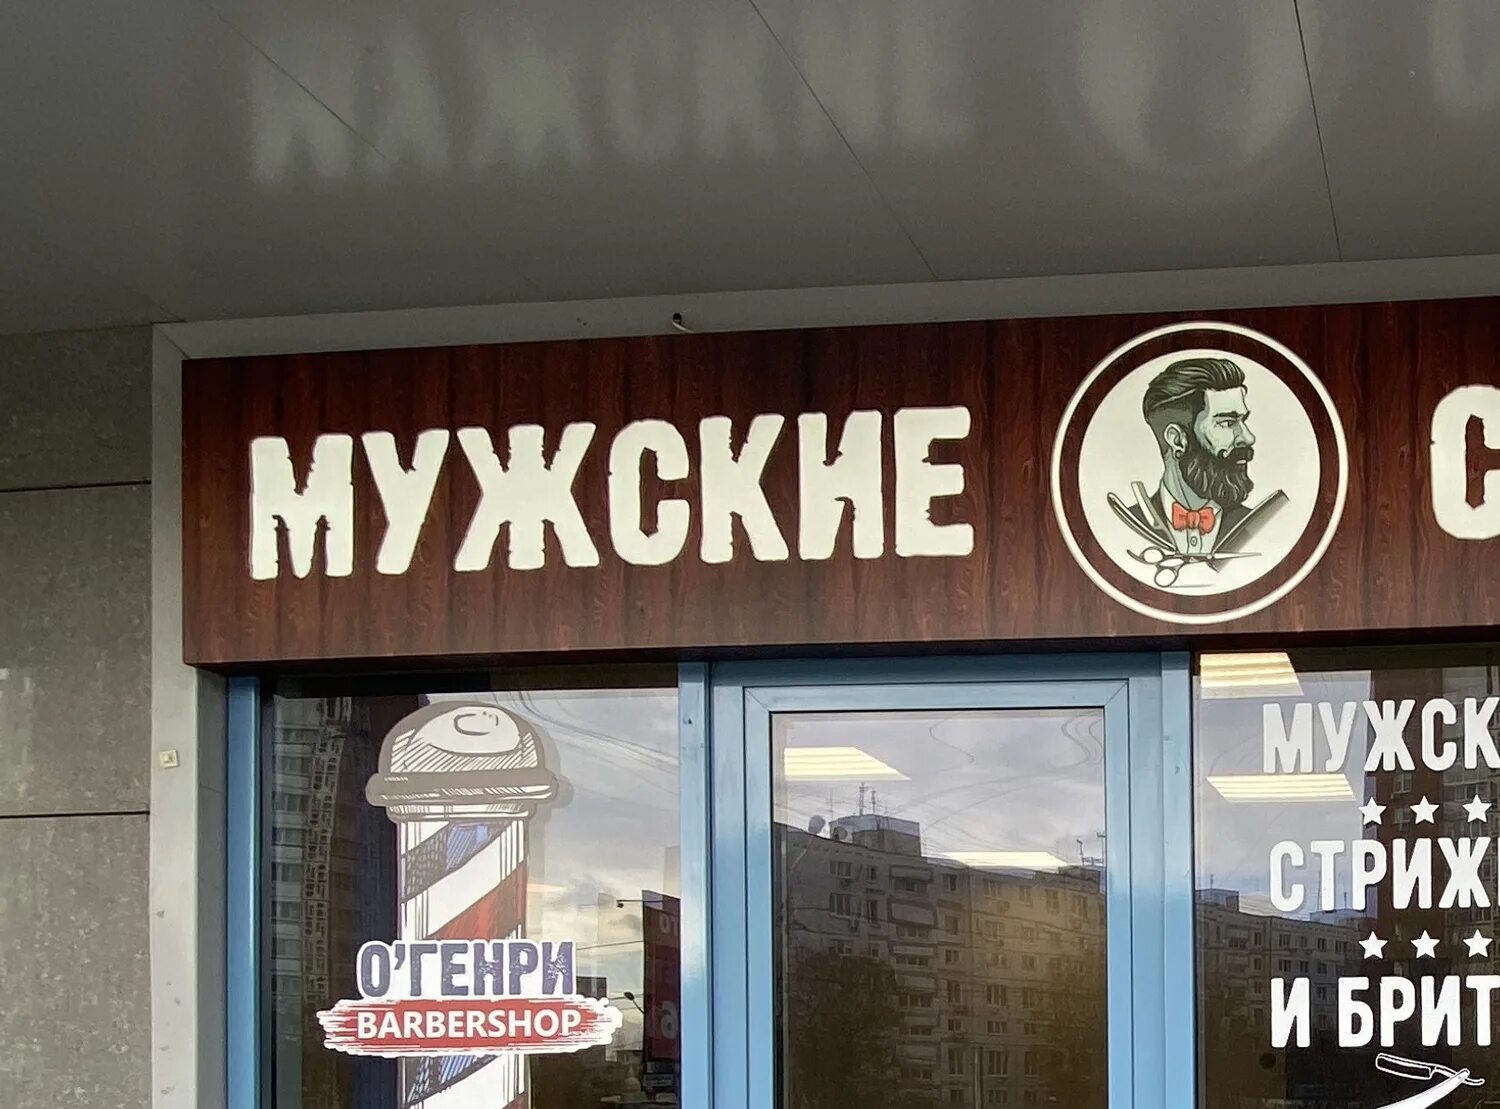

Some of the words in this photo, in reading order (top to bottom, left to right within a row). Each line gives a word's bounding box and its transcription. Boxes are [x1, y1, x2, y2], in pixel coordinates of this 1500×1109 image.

[250, 406, 974, 580] МУЖСКИЕ
[357, 1009, 582, 1039] BARBERSHOP
[1270, 977, 1311, 1048] И
